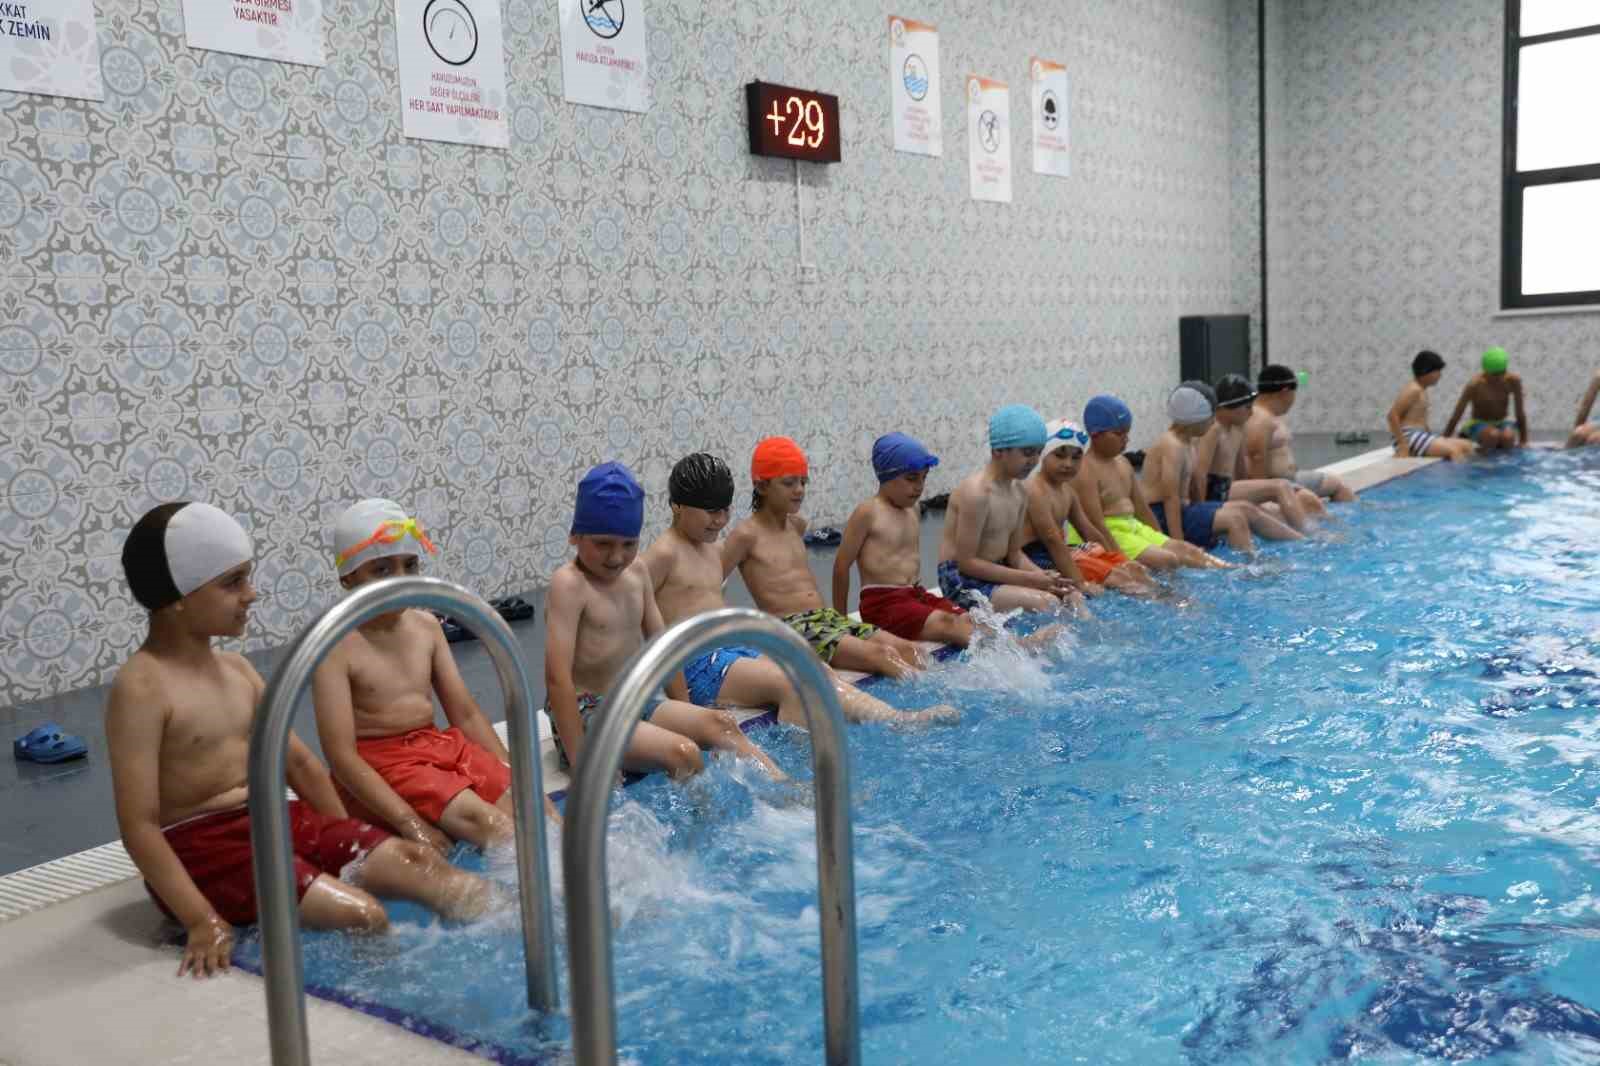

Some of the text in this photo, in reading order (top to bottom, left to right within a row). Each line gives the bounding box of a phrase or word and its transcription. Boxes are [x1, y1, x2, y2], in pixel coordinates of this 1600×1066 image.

[233, 7, 278, 25] YASAKTIR
[8, 20, 50, 40] ZEMİN
[409, 98, 424, 112] HER
[426, 100, 444, 113] SAAT
[766, 96, 824, 148] +29
